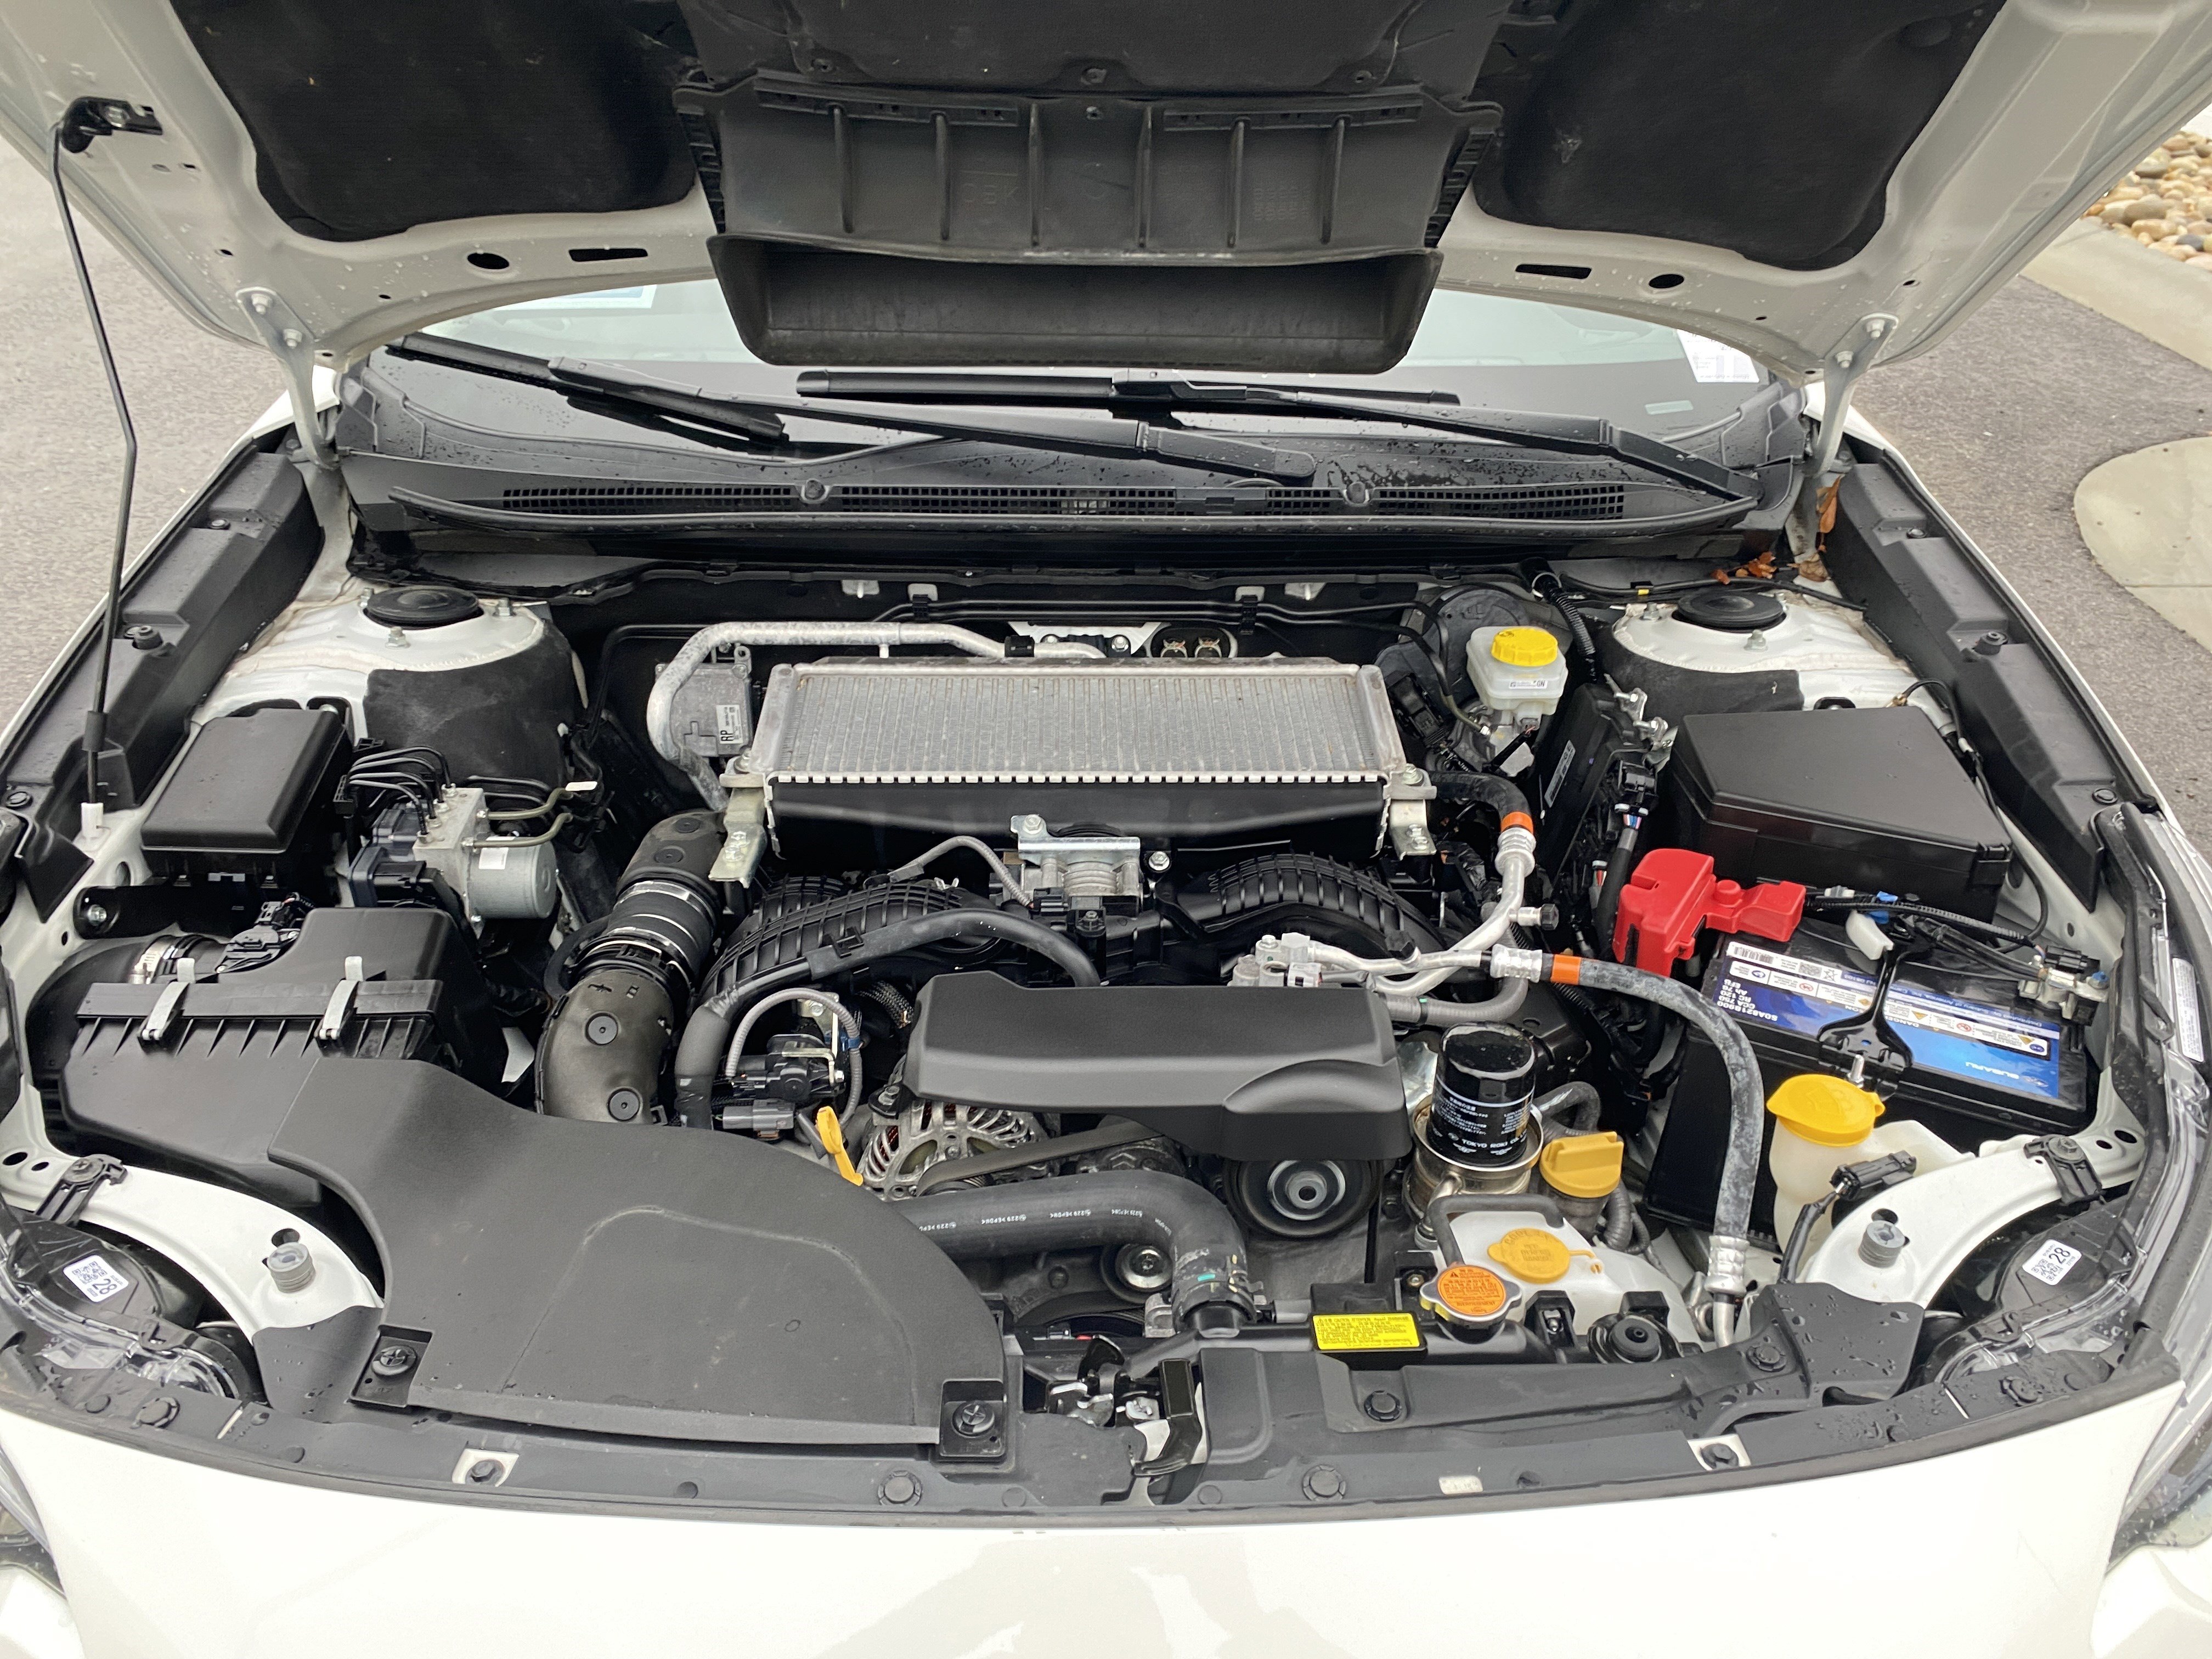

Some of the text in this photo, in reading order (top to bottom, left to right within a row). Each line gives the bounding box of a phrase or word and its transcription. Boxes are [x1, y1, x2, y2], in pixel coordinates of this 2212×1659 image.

[720, 730, 734, 741] RP
[1720, 989, 1736, 999] 120
[1737, 1000, 1756, 1009] CCA
[1965, 1062, 2020, 1079] SUBARU
[1462, 1138, 1487, 1148] TOKYO
[2049, 1247, 2070, 1265] 28
[92, 1278, 117, 1295] 28
